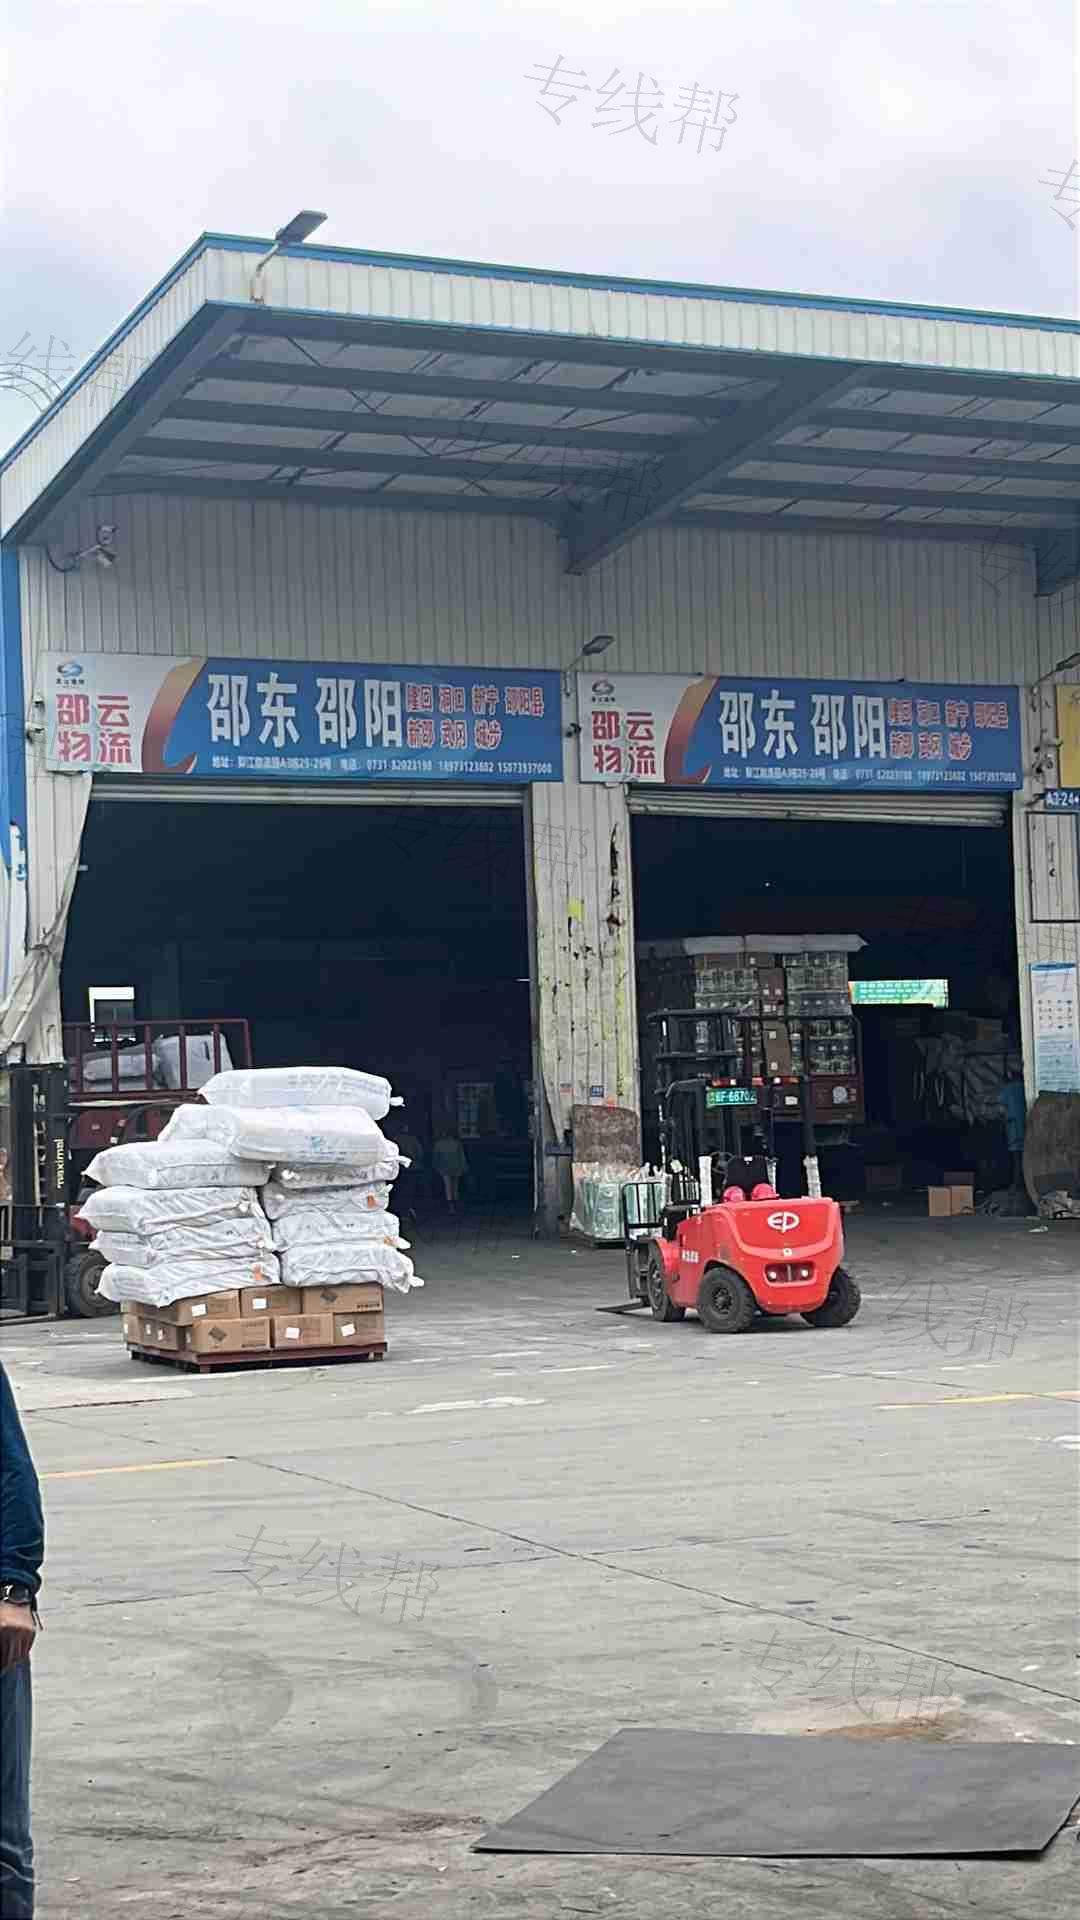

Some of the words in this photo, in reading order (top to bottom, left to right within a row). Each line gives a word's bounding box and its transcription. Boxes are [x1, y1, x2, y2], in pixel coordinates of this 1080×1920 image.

[56, 694, 130, 726] 邵云
[207, 672, 300, 748] 邵东
[316, 678, 403, 750] 邵阳
[592, 711, 655, 740] 邵云
[719, 689, 799, 759] 邵东
[811, 694, 887, 760] 邵阳
[58, 731, 132, 764] 物流
[593, 744, 657, 775] 物流
